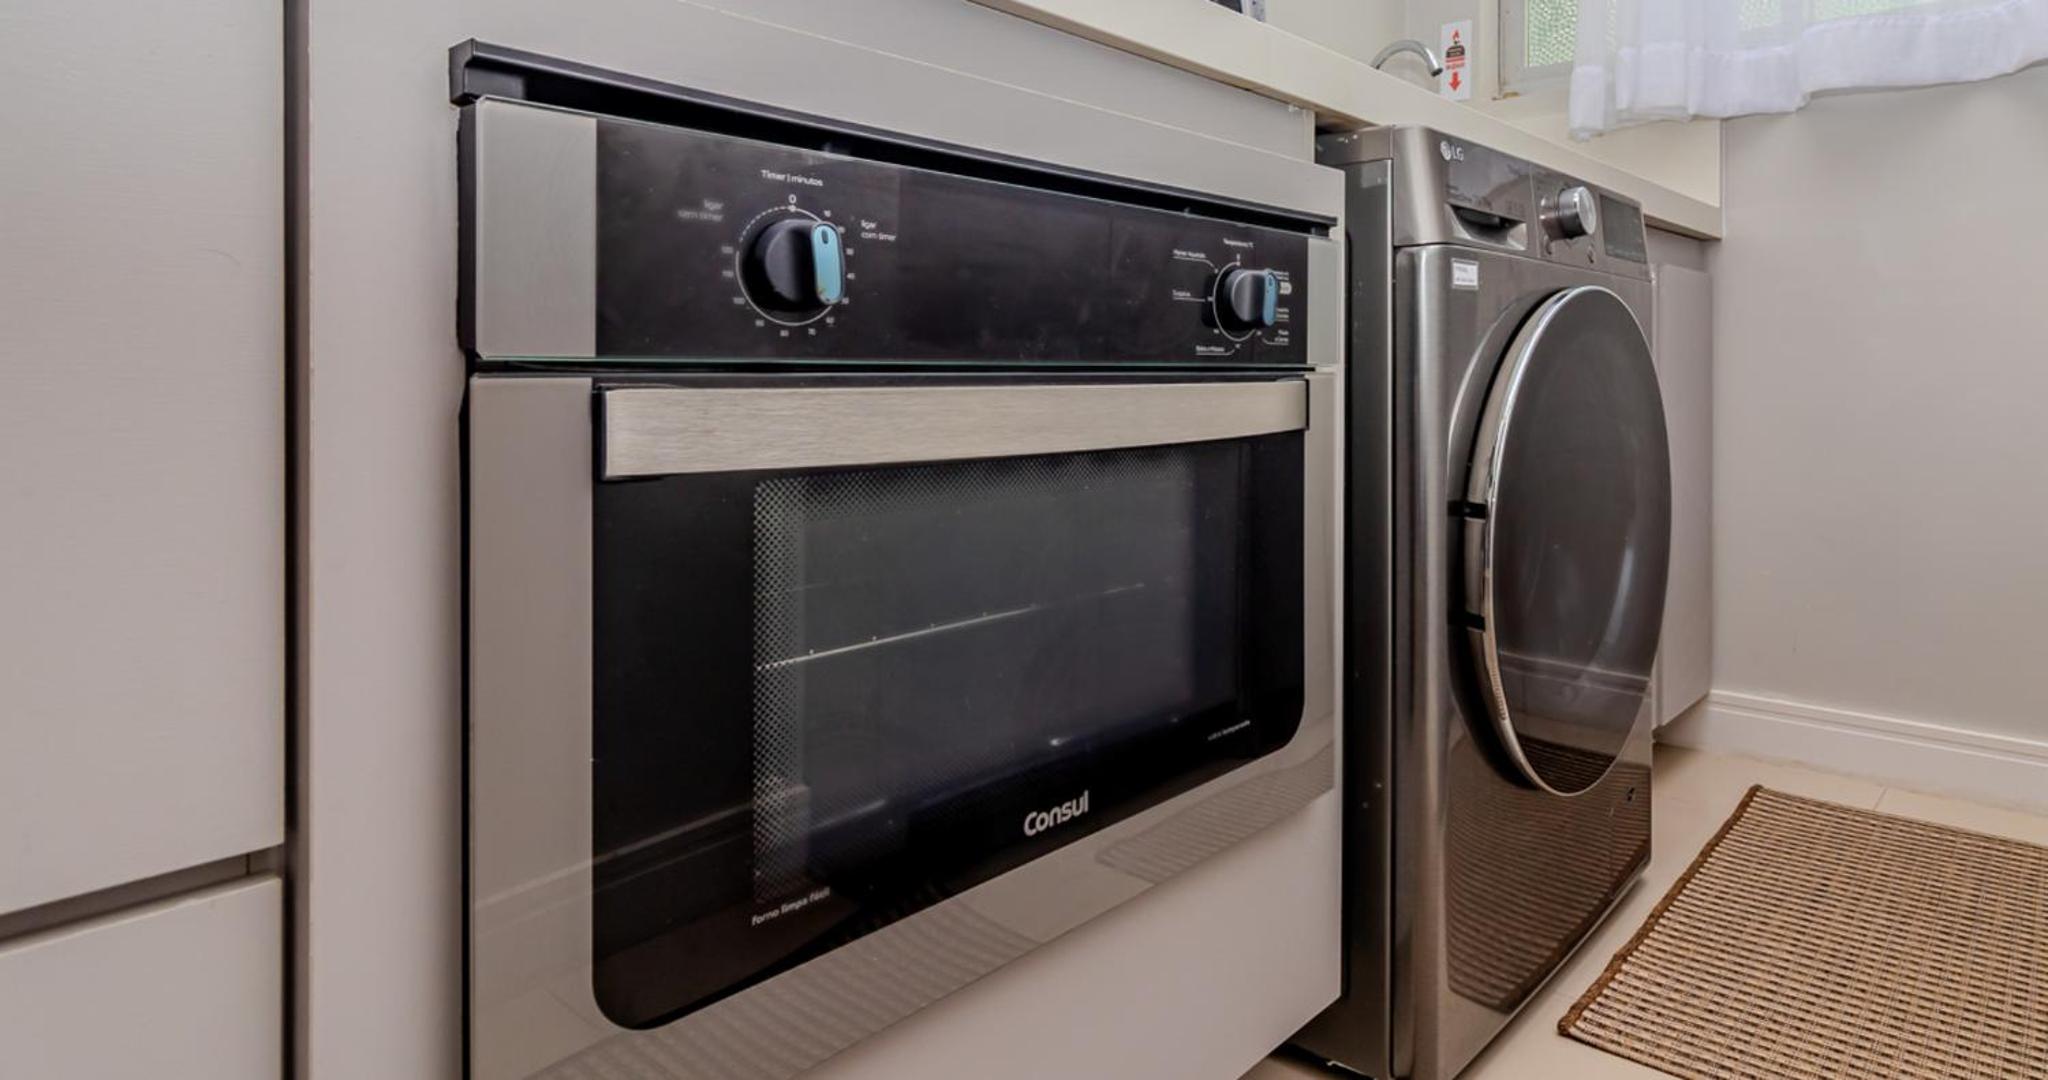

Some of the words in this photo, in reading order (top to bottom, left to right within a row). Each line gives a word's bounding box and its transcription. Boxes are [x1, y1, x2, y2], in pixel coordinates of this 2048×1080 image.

[760, 169, 785, 180] Timer
[791, 175, 823, 187] minutos
[1023, 789, 1089, 836] Consul
